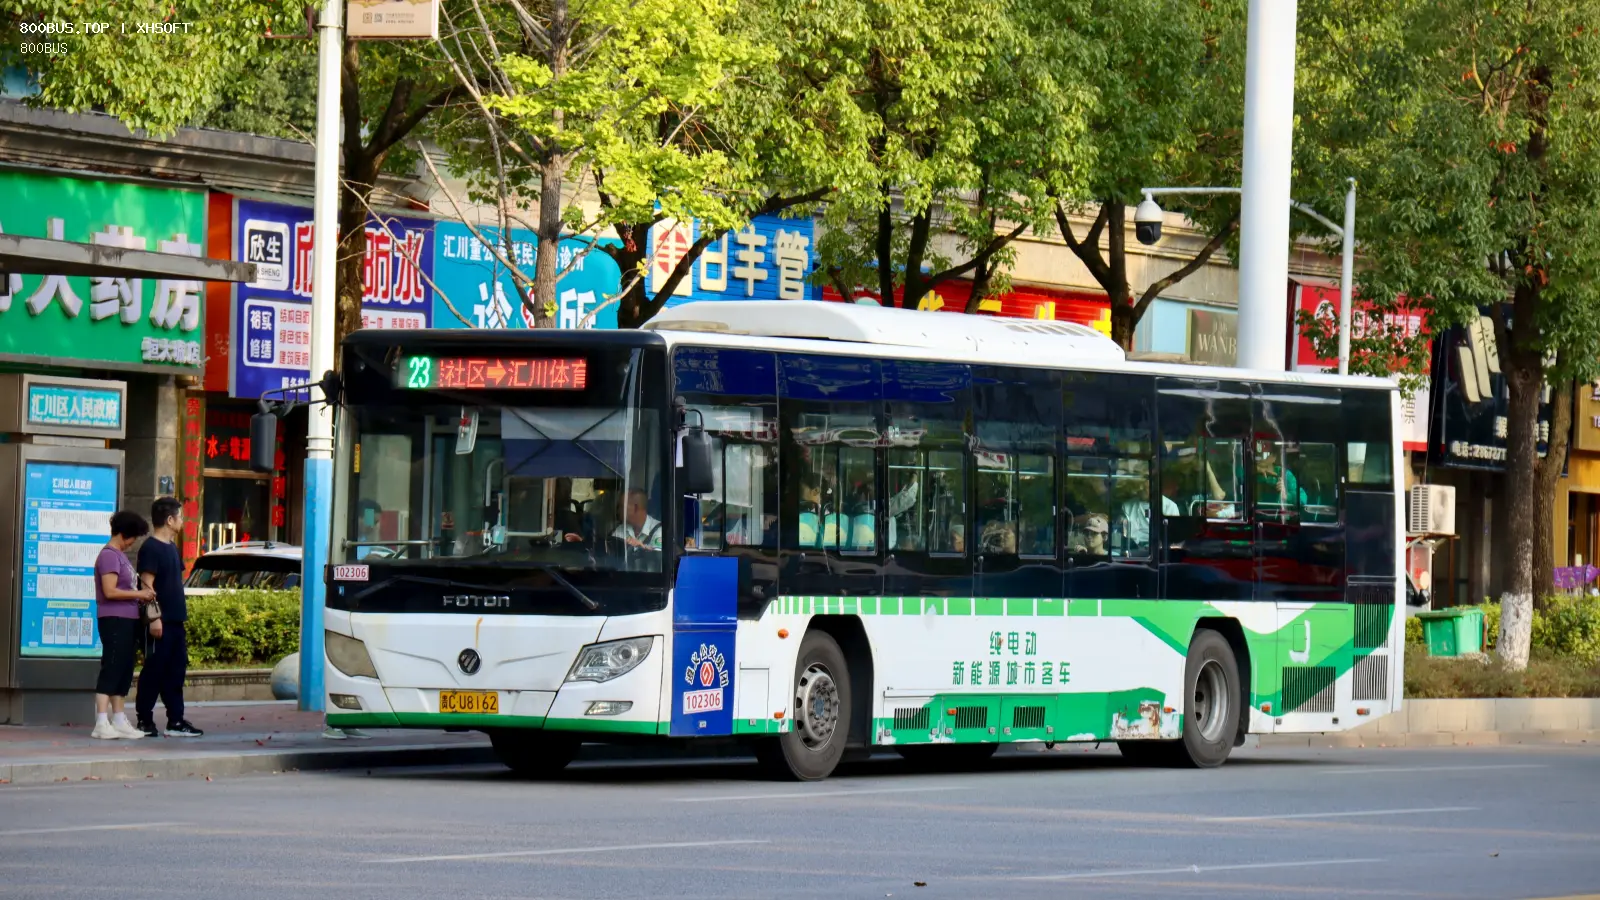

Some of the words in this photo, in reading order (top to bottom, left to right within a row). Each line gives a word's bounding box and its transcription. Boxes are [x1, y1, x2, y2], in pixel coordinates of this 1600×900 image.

[250, 234, 281, 262] 欣生
[0, 217, 201, 332] 大药房
[261, 268, 281, 278] SHENG
[408, 356, 431, 388] 23
[439, 359, 489, 388] 社区
[508, 359, 587, 388] 汇川体育
[32, 393, 118, 420] 汇川区人民政府
[335, 567, 367, 578] 102306
[443, 595, 510, 608] FOTON
[989, 631, 1037, 656] 纯电动
[952, 660, 1071, 686] 新能源城市客车
[686, 692, 721, 709] 102306
